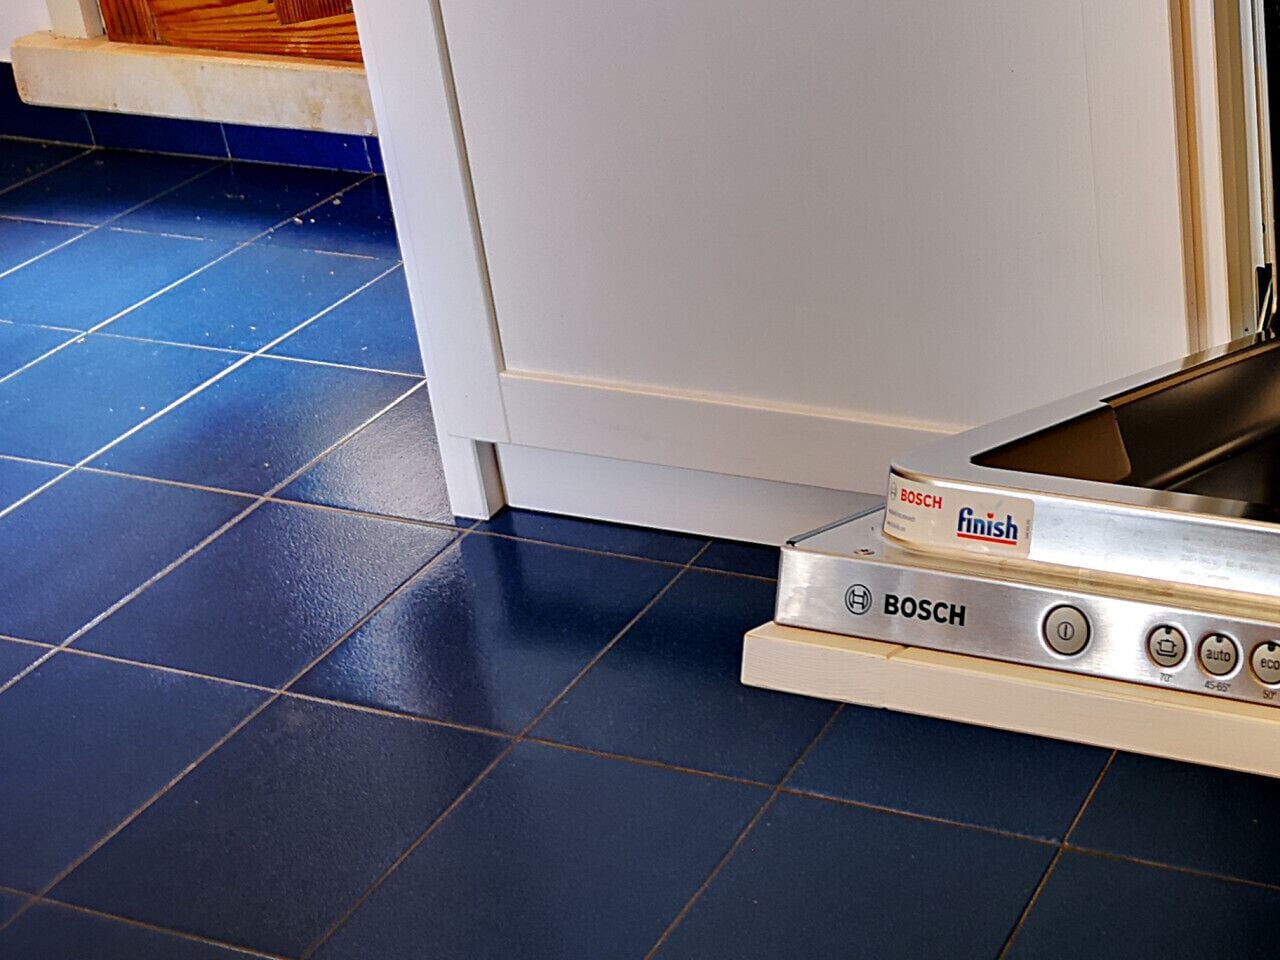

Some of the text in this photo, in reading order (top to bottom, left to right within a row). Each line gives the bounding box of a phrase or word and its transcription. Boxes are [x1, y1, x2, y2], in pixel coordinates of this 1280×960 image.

[900, 488, 943, 509] BOSCH
[957, 506, 1018, 540] finish
[884, 593, 966, 626] BOSCH
[1206, 647, 1231, 662] auto
[1260, 658, 1280, 671] eco
